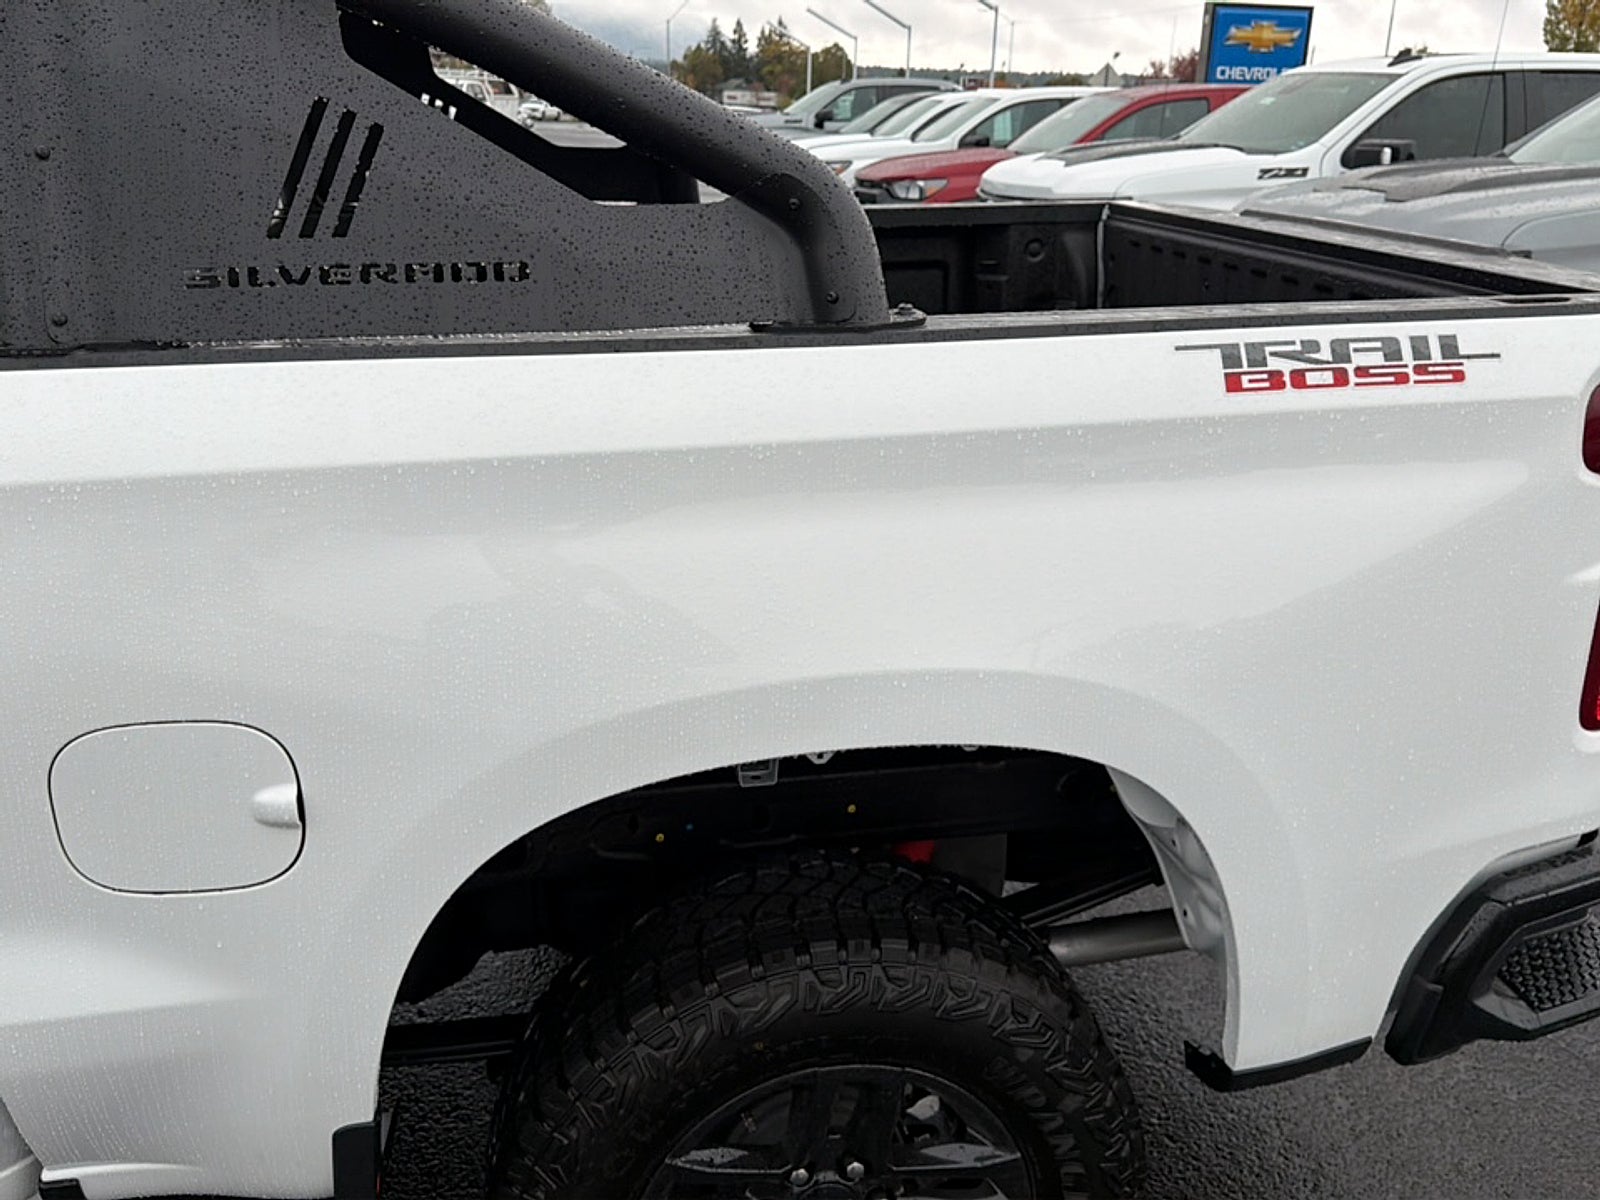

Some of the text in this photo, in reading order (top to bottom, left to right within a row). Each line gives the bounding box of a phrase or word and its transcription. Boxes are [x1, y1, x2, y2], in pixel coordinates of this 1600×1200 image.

[1216, 65, 1288, 80] CHEVRO
[185, 262, 531, 289] SILVERADO
[1174, 334, 1501, 369] TRAIL
[1224, 361, 1465, 393] BOSS
